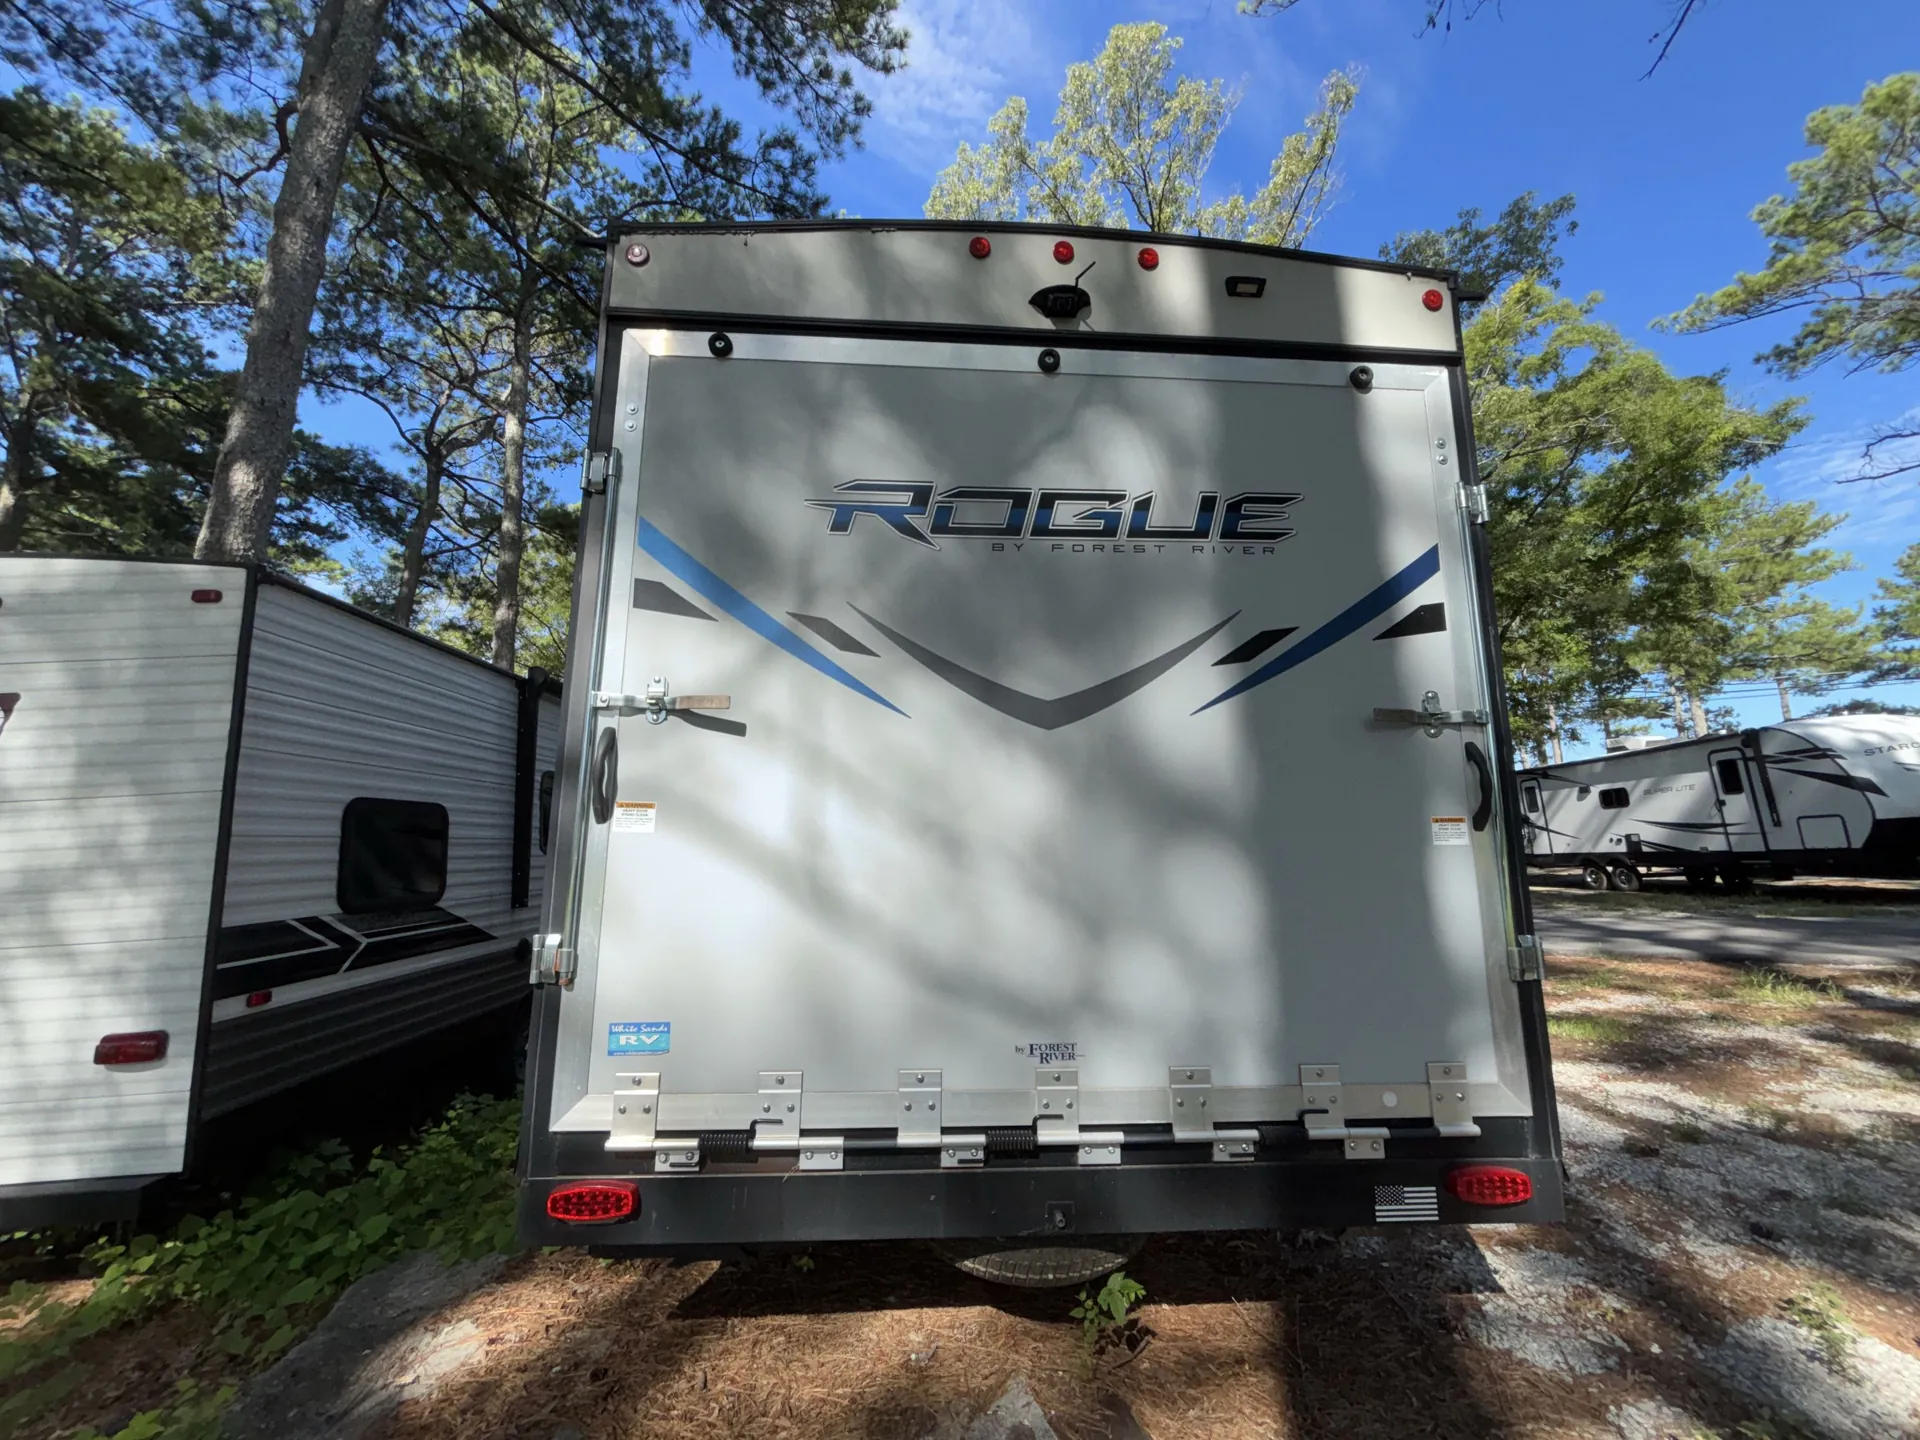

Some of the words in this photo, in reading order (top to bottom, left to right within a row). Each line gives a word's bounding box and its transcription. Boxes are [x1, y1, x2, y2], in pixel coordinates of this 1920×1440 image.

[804, 478, 1304, 551] ROGUE
[992, 543, 1024, 552] BY
[1052, 544, 1165, 554] FOREST
[1192, 545, 1276, 555] RIVER
[612, 1024, 638, 1033] White
[640, 1024, 668, 1033] Sands
[619, 1035, 660, 1045] RV
[1015, 1045, 1025, 1054] by
[1028, 1043, 1077, 1056] FOREST
[1039, 1052, 1076, 1065] RIVER
